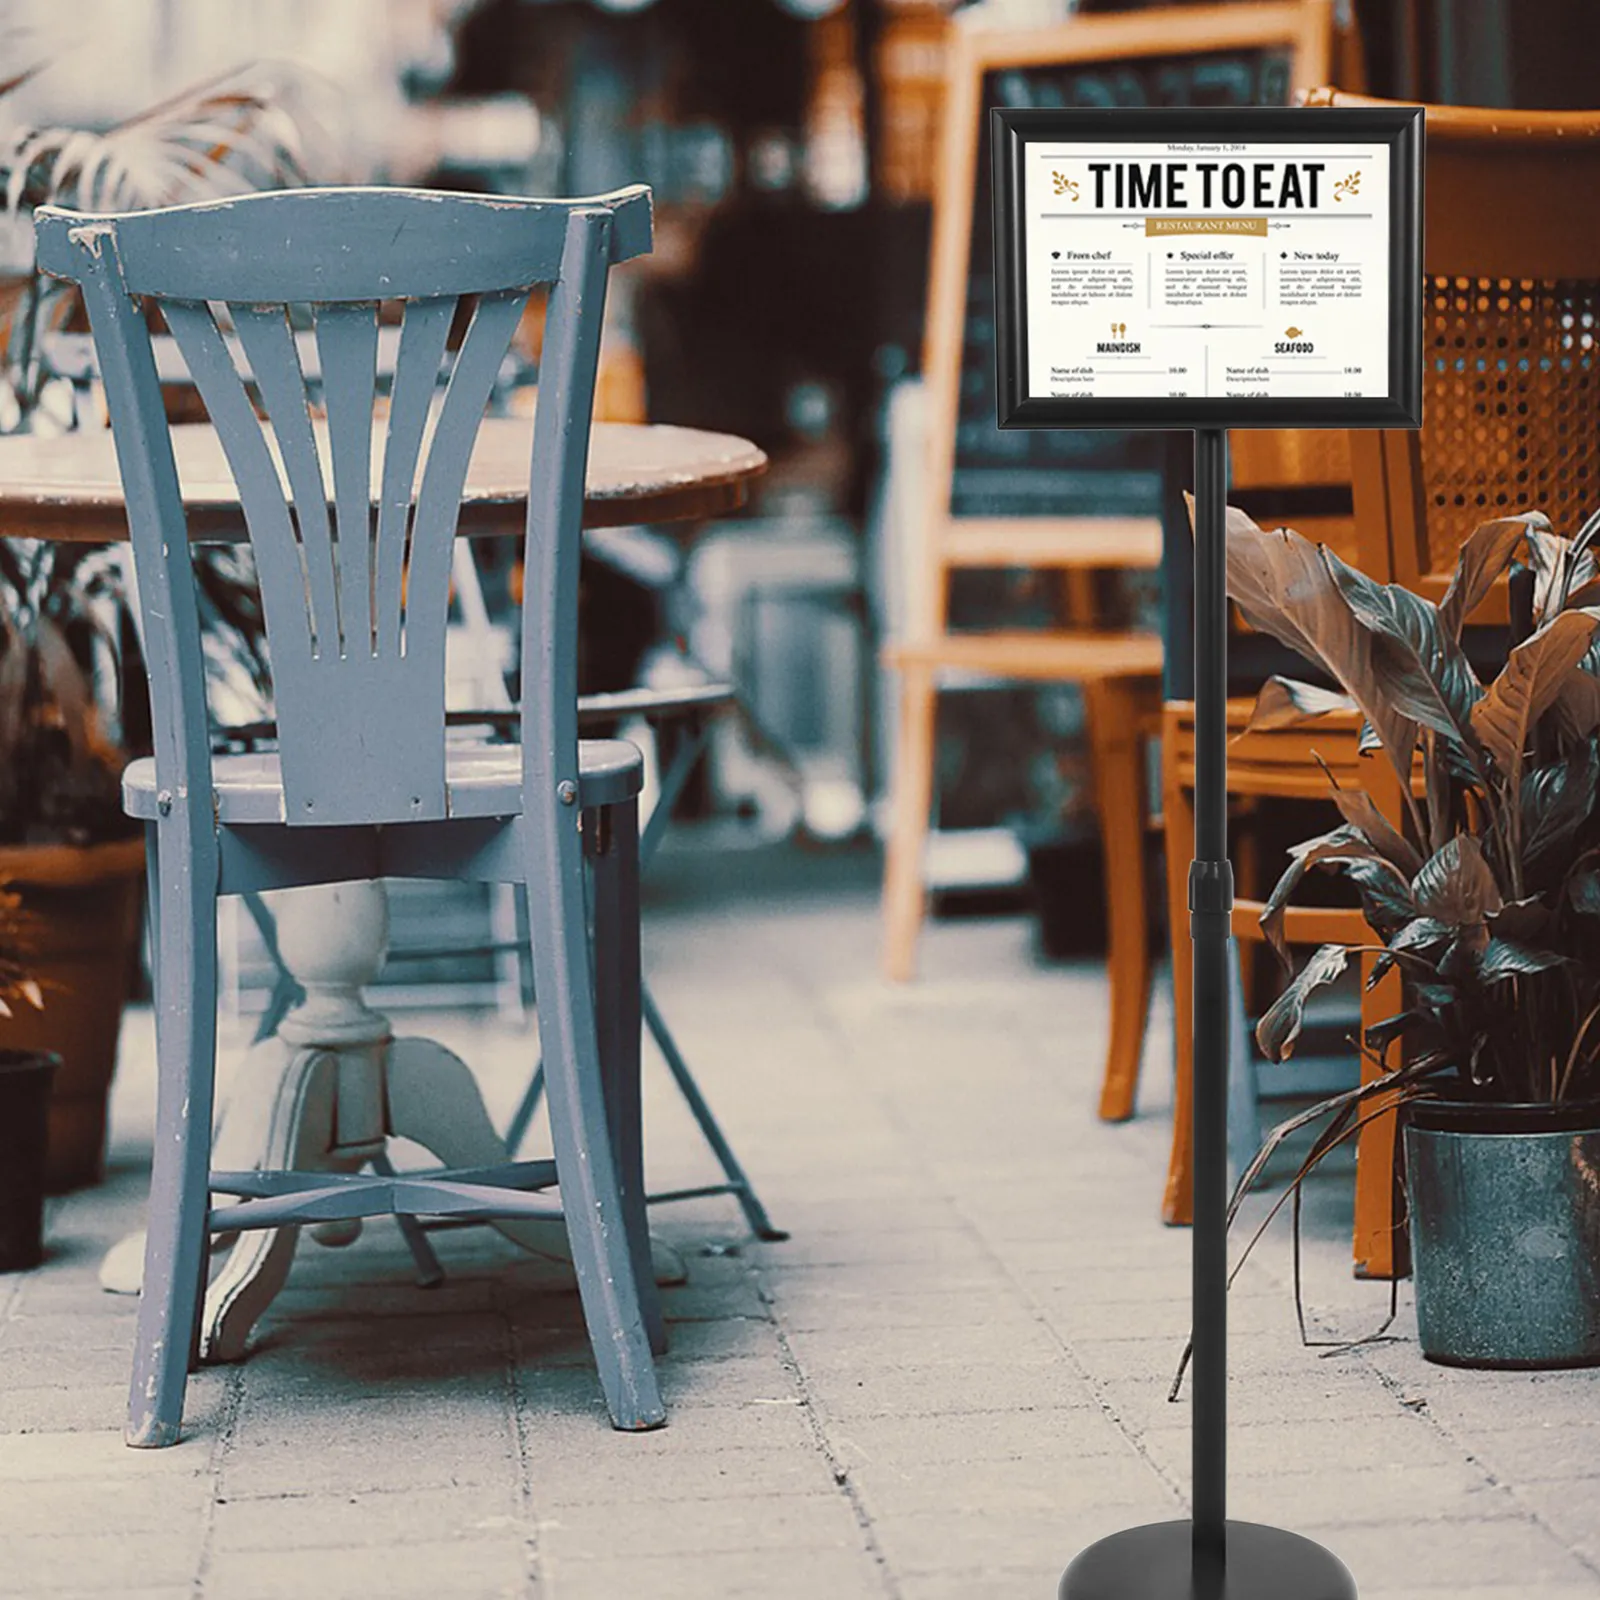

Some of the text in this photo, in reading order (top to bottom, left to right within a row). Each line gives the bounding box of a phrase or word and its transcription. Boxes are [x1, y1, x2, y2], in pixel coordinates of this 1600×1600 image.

[1088, 163, 1325, 208] TIME TO EAT
[1156, 221, 1257, 231] RESTAURANT MENU
[1067, 251, 1112, 260] From chef
[1180, 251, 1234, 261] Special offer
[1294, 251, 1340, 262] New today
[1274, 342, 1314, 353] SEAFOOD
